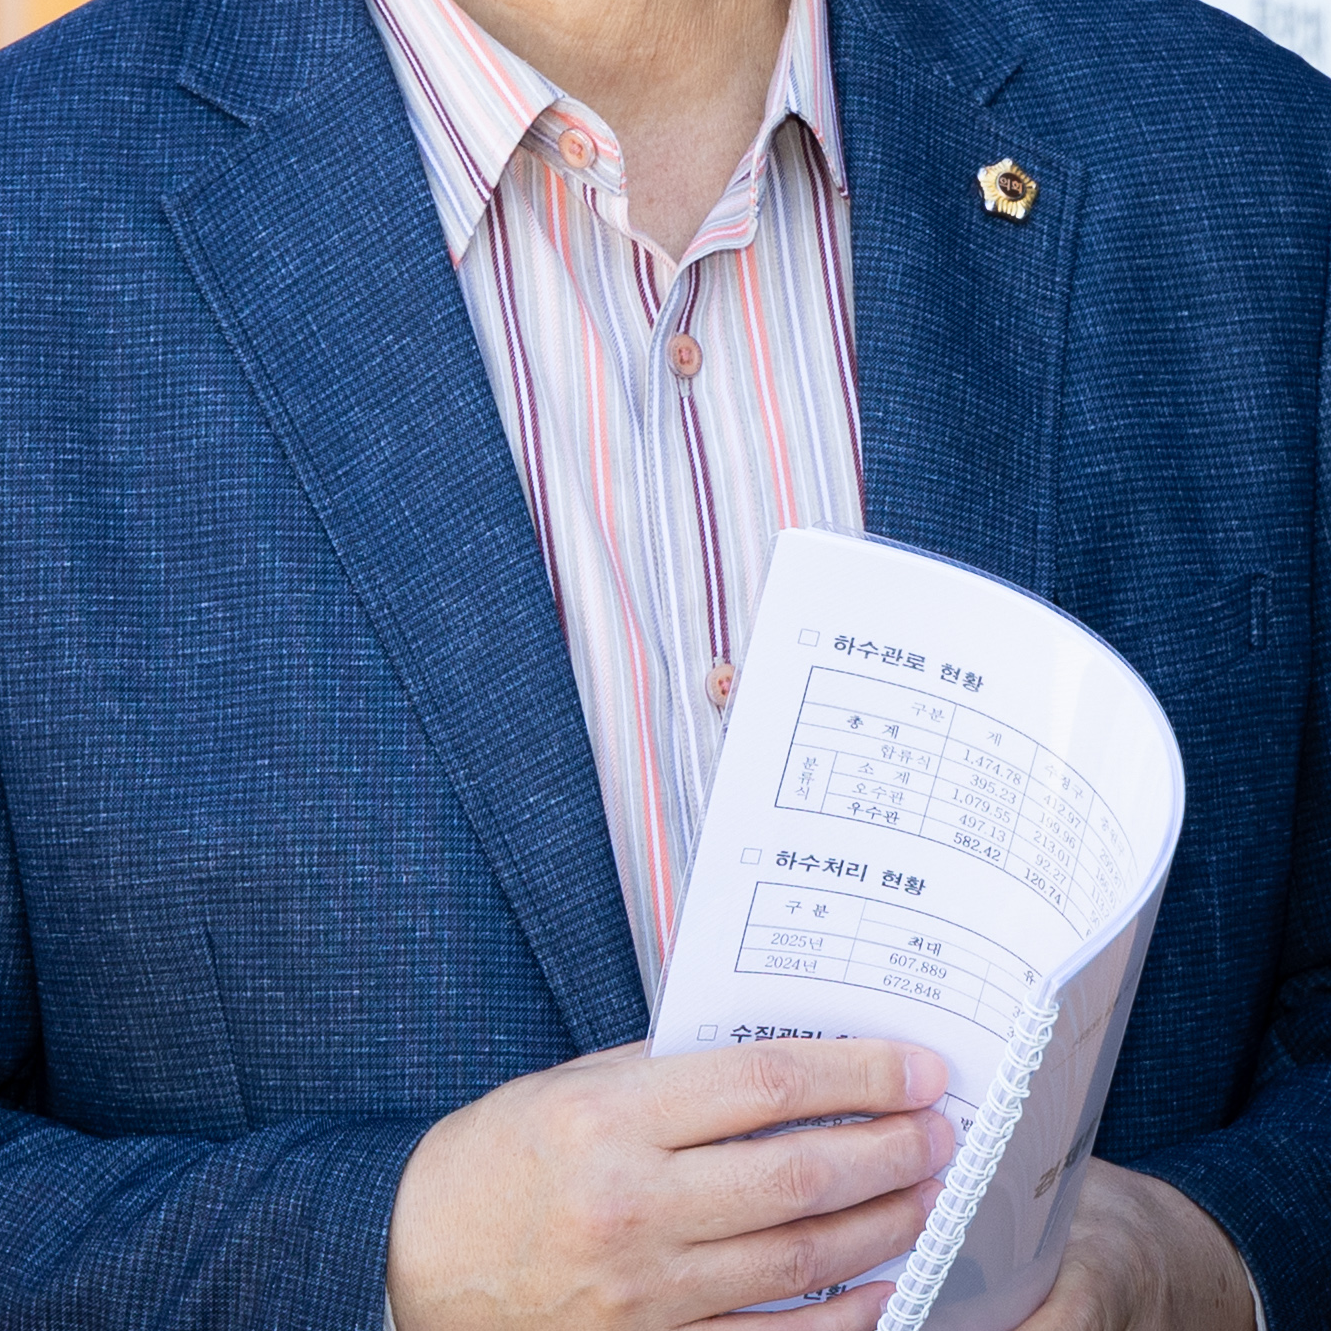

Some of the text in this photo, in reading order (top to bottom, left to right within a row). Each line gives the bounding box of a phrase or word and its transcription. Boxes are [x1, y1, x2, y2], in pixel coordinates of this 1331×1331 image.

[999, 176, 1023, 194] 의회
[833, 635, 984, 693] 하수관로 현황
[911, 701, 946, 723] 구분
[881, 744, 931, 770] 합류식
[852, 783, 905, 806] 오수관
[969, 774, 1017, 805] 395.23
[1044, 764, 1084, 799] 수정구
[847, 801, 900, 825] 우수관
[1043, 794, 1082, 829] 412.97
[959, 813, 1007, 843] 497.13
[1039, 812, 1077, 850] 199.96
[953, 831, 1001, 862] 582.42
[1033, 830, 1071, 867] 213.01
[775, 850, 928, 897] 하수처리 현황
[1035, 853, 1067, 886] 92.27
[1024, 868, 1062, 905] 120.74
[770, 932, 824, 952] 2025년
[907, 936, 942, 957] 최대
[764, 954, 818, 974] 2024년
[889, 953, 947, 980] 607,889
[882, 974, 942, 1001] 672,848
